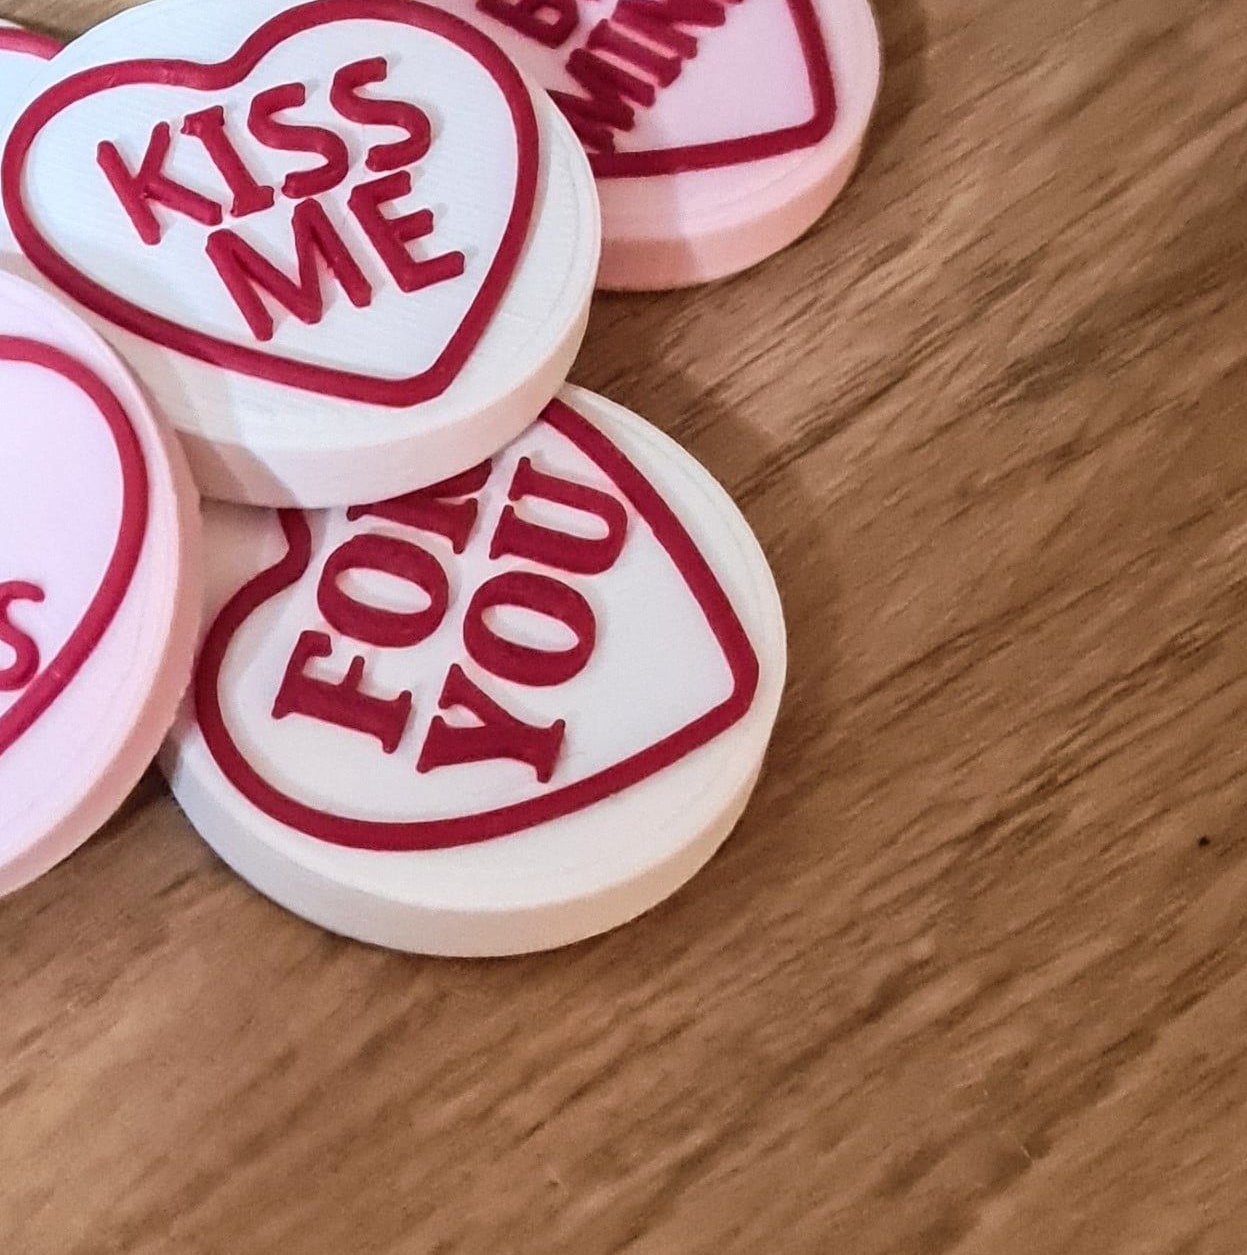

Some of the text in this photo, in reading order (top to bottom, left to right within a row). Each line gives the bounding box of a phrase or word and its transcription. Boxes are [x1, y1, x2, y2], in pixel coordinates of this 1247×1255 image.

[97, 56, 432, 245] KISS
[205, 170, 465, 342] ME
[416, 455, 629, 784] YOU
